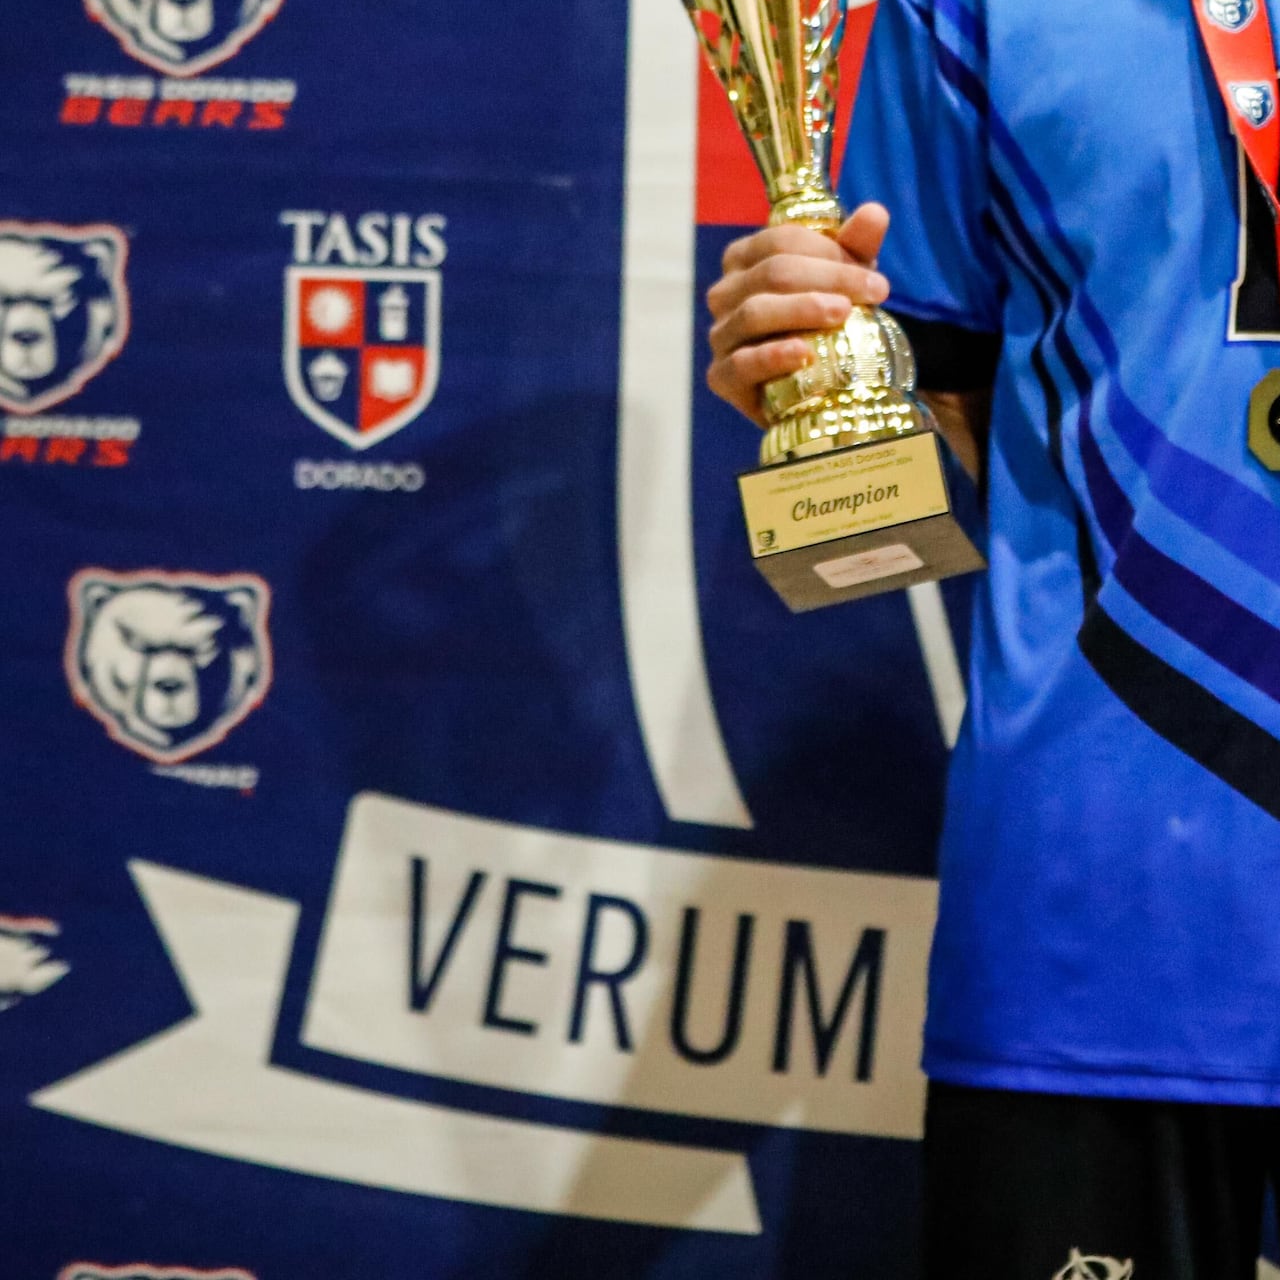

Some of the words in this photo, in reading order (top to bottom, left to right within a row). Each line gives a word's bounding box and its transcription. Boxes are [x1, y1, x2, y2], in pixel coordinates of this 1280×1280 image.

[280, 210, 447, 265] TASIS
[294, 459, 425, 492] DORADO
[791, 483, 900, 522] Champion
[406, 856, 888, 1085] VERUM
